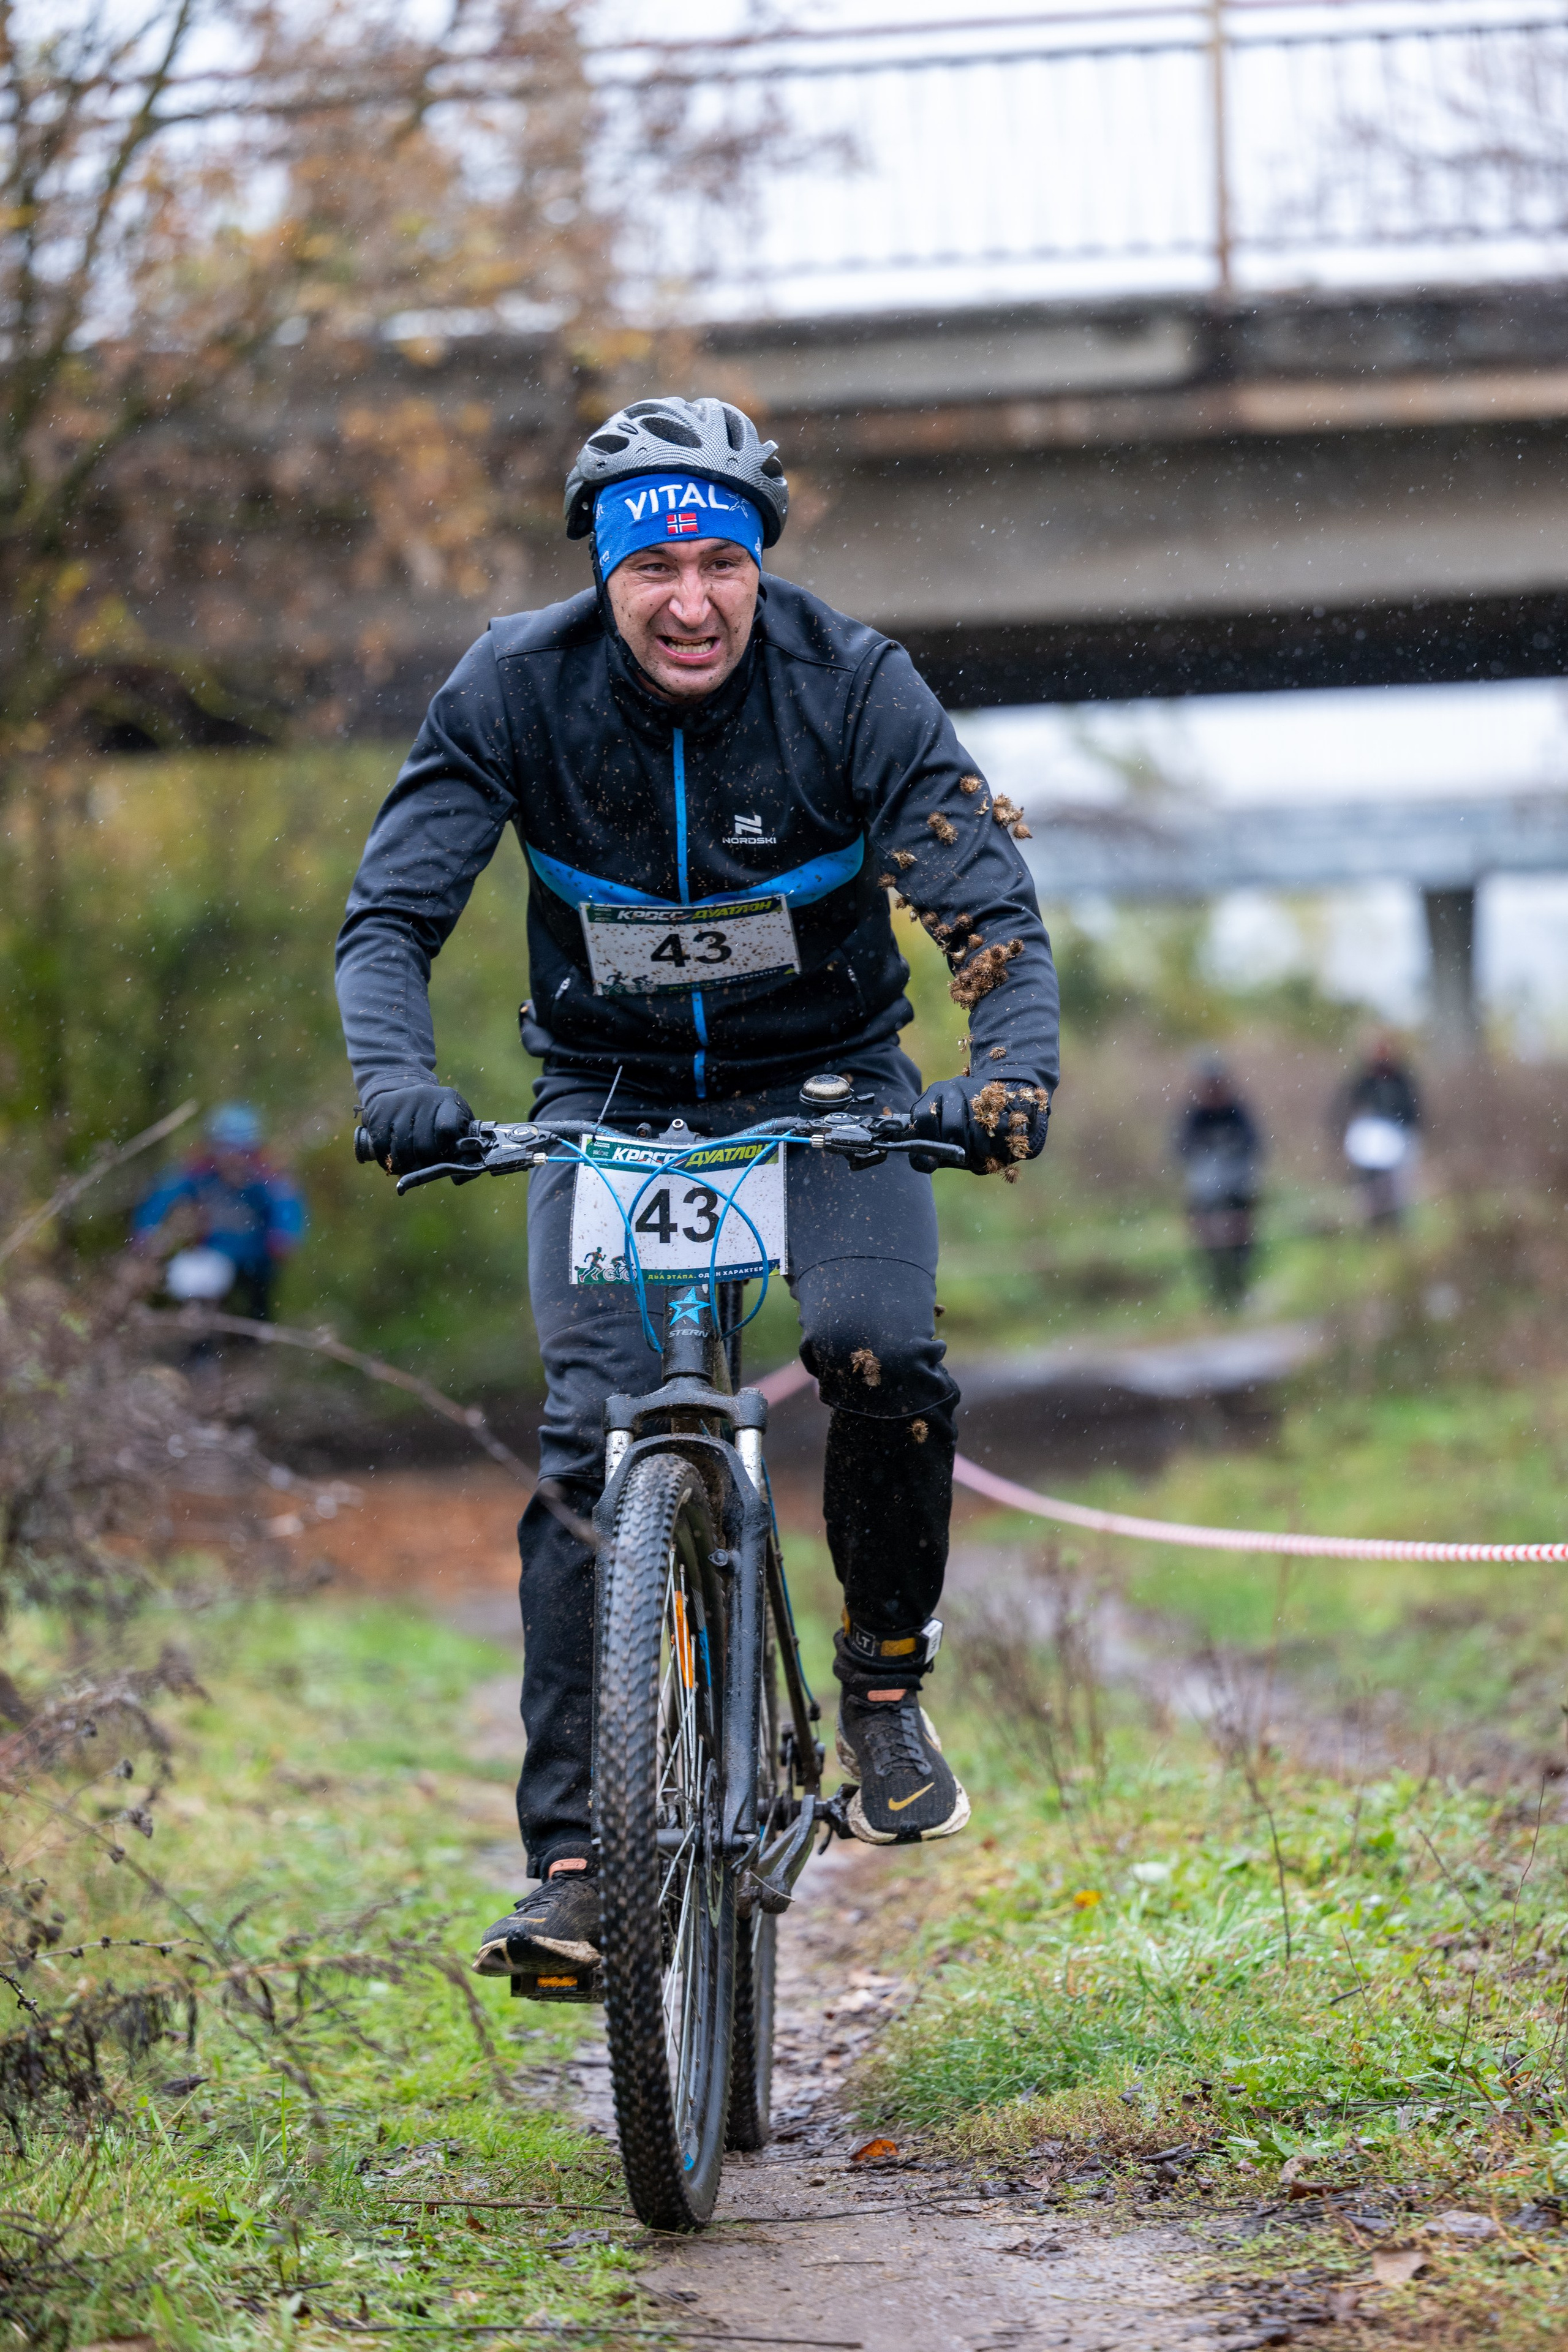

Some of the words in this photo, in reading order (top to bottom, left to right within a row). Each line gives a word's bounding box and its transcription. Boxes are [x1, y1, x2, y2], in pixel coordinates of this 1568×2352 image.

[624, 482, 729, 520] VITAL
[616, 909, 685, 921] КРОСС
[691, 900, 772, 919] ДУАТЛОН
[650, 930, 733, 968] 43
[612, 1147, 685, 1167] КРОСС
[635, 1186, 722, 1244] 43
[668, 1329, 709, 1338] STERN
